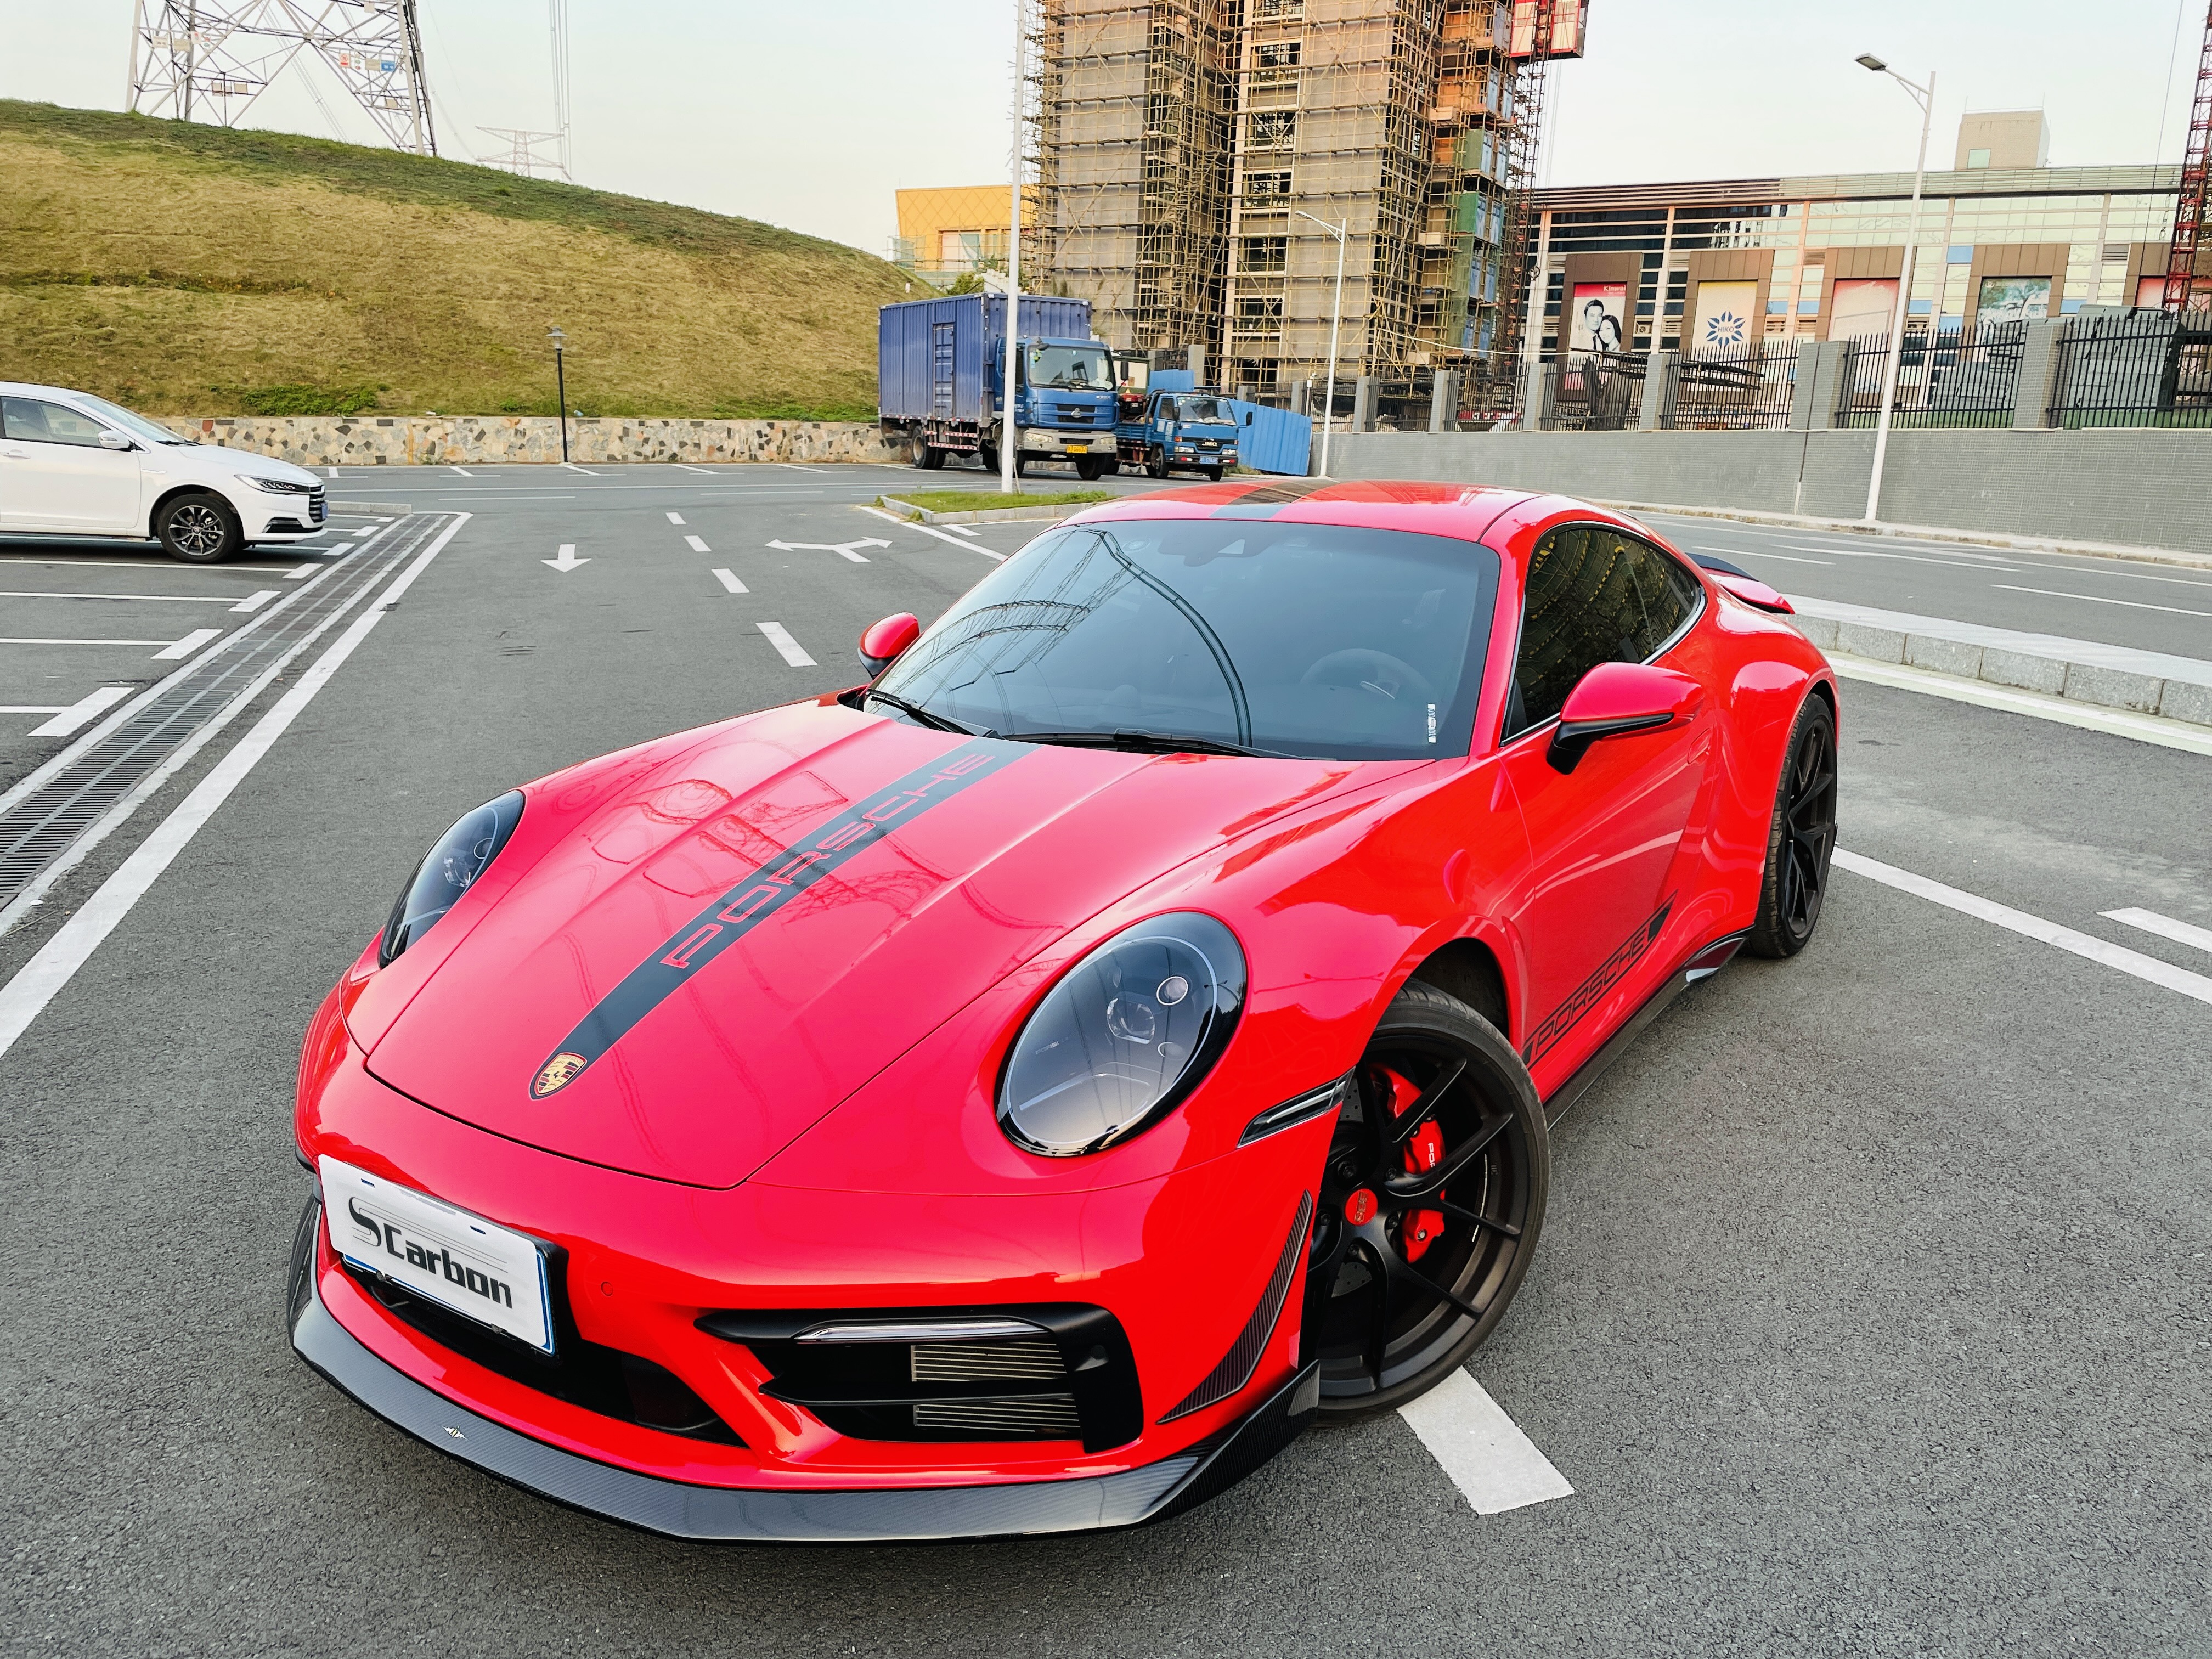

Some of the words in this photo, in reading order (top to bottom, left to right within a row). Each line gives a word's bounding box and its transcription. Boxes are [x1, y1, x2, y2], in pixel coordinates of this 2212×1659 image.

[660, 753, 996, 970] PORSCHE
[1535, 935, 1645, 1055] PORSCHE
[383, 1222, 513, 1309] Carbon
